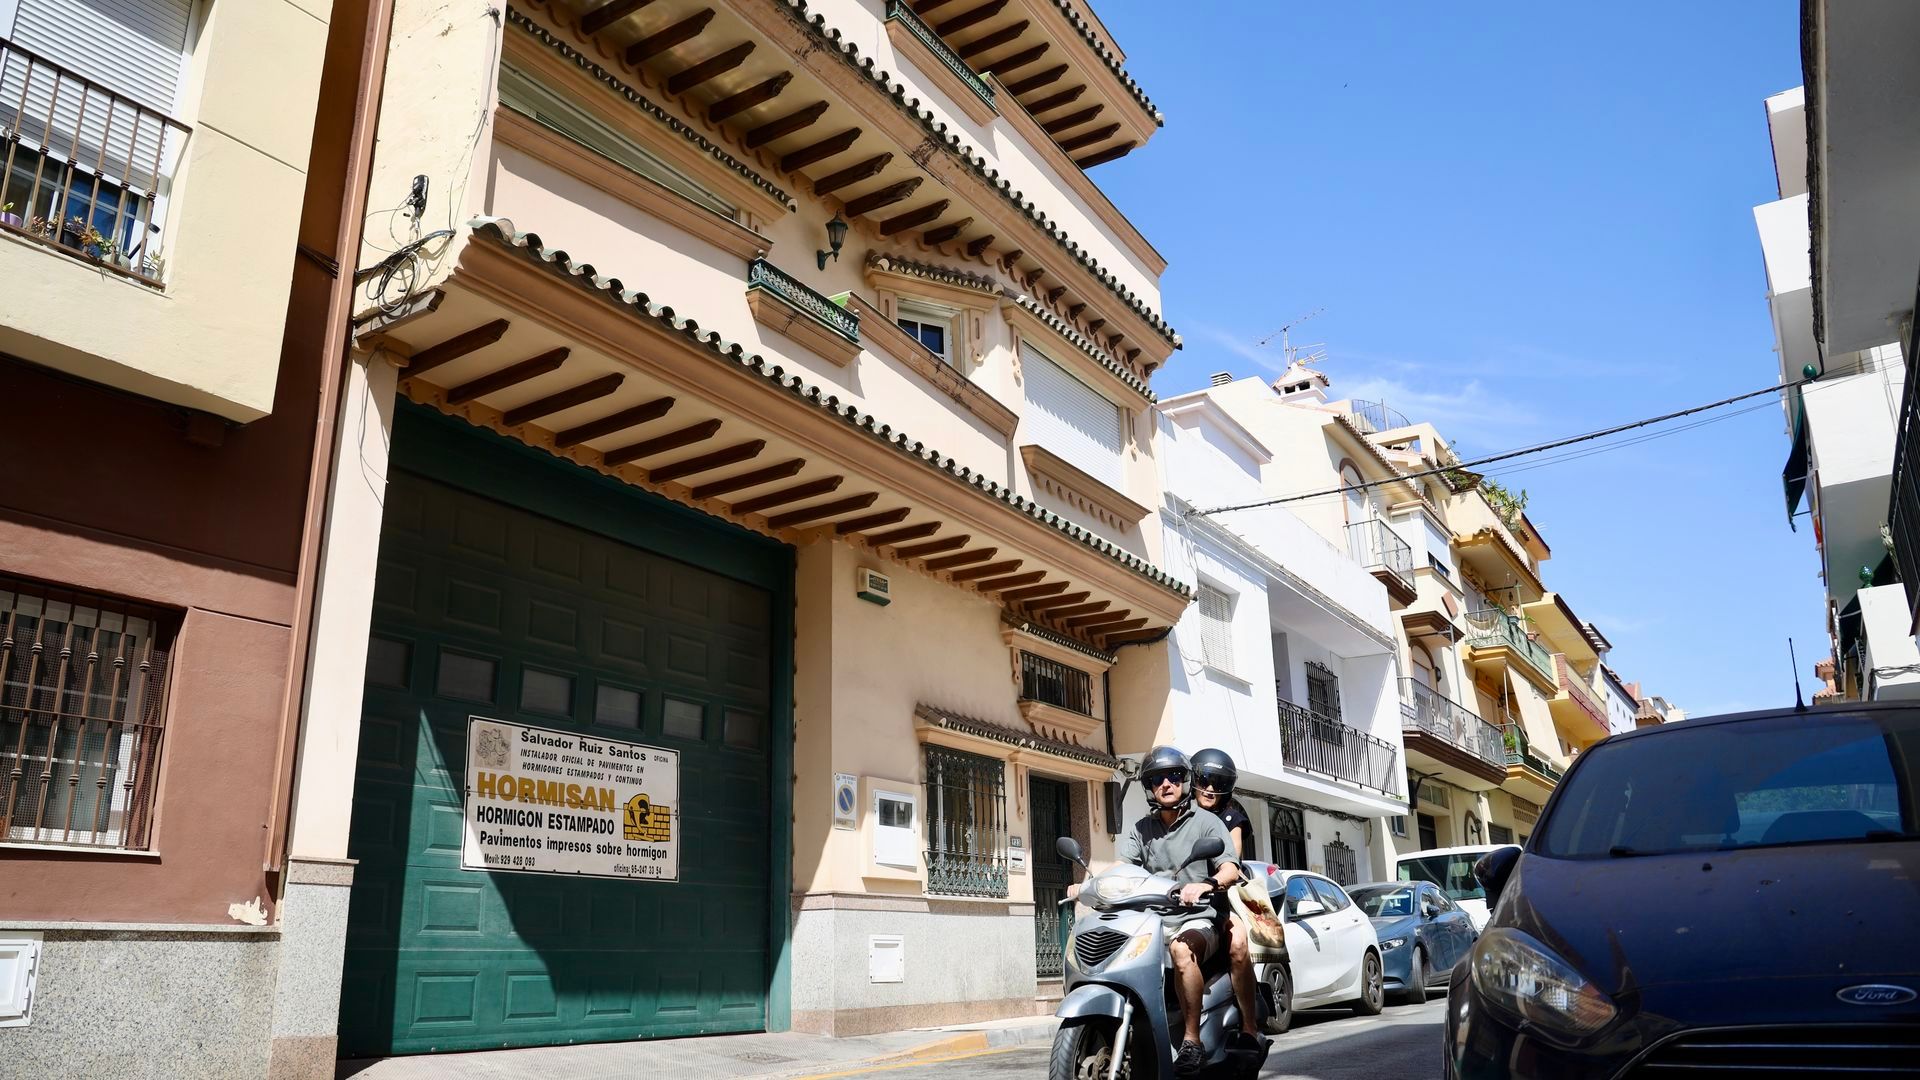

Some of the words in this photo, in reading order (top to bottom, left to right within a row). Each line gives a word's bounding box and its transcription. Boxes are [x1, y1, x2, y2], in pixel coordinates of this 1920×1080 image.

[520, 748, 558, 762] INSTALADOR
[561, 755, 583, 766] OFICIAL
[587, 758, 595, 767] DE
[598, 760, 633, 773] PAVIMENTOS
[636, 766, 645, 774] EN
[521, 731, 573, 749] Salvador
[580, 740, 603, 754] Ruiz
[609, 746, 646, 761] Santos
[522, 762, 563, 775] HORMIGONES
[566, 768, 605, 781] ESTAMPADOS
[608, 774, 612, 782] Y
[615, 775, 643, 786] CONTINUO
[477, 771, 616, 813] HORMISAN
[476, 805, 543, 828] HORMIGON
[548, 813, 615, 835] ESTAMPADO
[480, 830, 542, 849] Pavimentos
[546, 836, 592, 854] impresos
[596, 842, 622, 856] sobre
[626, 844, 667, 860] hormigon
[1855, 989, 1897, 1000] Ford
